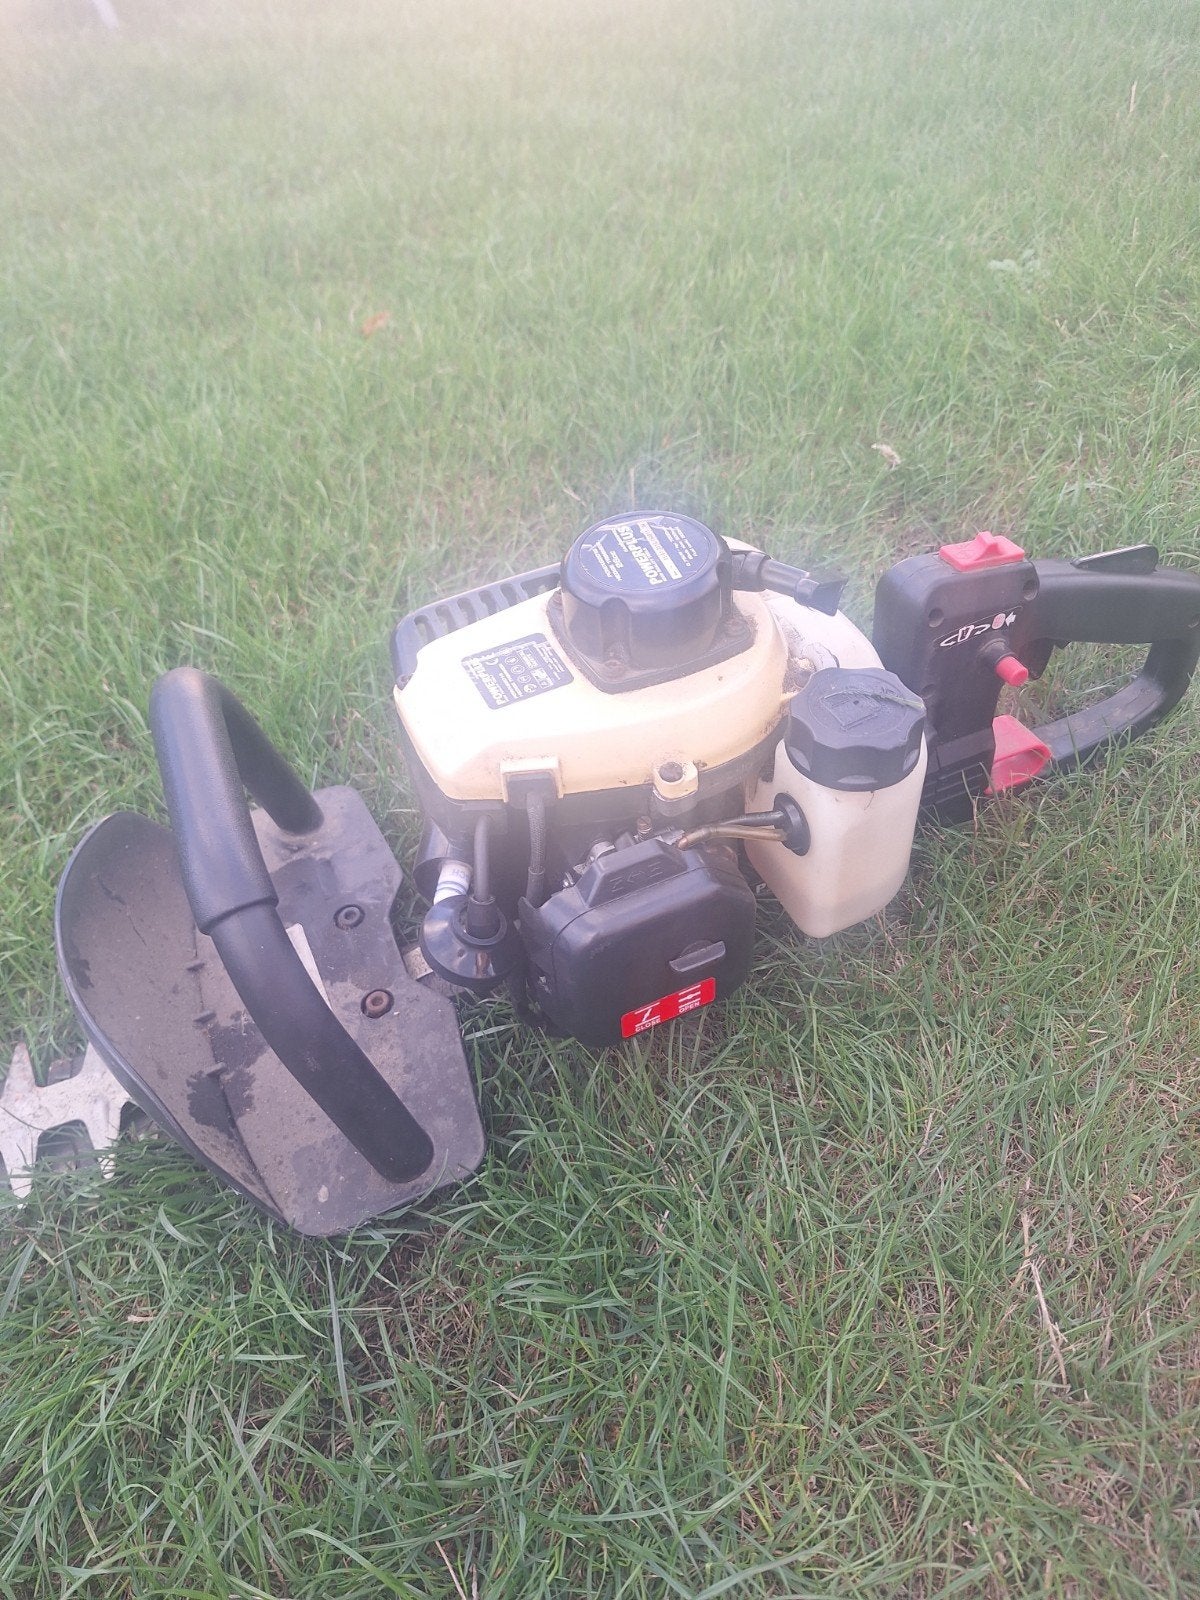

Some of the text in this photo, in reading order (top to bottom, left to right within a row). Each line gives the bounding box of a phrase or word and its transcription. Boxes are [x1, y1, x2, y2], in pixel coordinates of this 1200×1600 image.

[618, 525, 663, 585] POWERPLUS
[679, 1001, 700, 1013] OPEN
[635, 1018, 661, 1033] CLOSE
